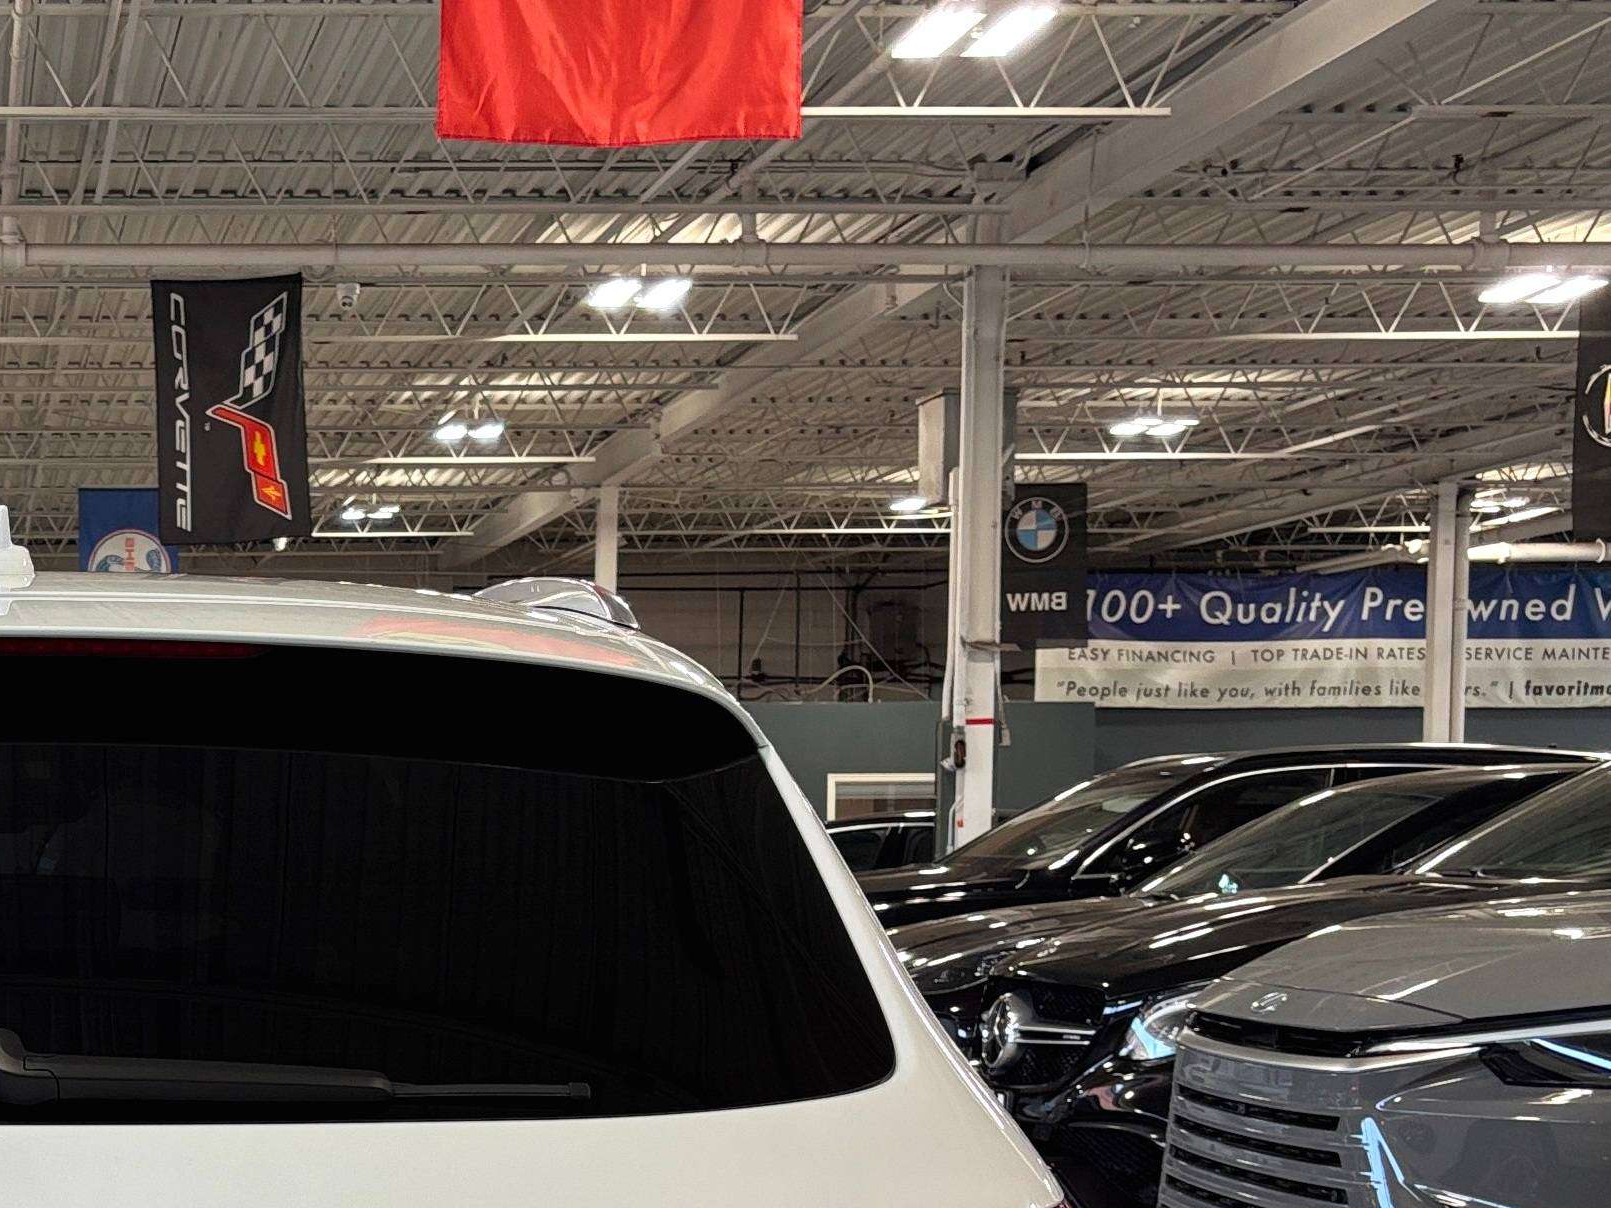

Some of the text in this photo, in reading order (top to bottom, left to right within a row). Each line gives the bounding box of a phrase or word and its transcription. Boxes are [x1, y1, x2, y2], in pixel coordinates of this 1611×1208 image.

[169, 292, 192, 532] CORVETTE
[1199, 587, 1345, 633] Quality
[1067, 648, 1110, 662] EASY
[1117, 649, 1216, 663] FINANCING
[1251, 648, 1285, 663] TOP
[1293, 646, 1368, 662] TRADE-IN
[1376, 646, 1426, 661] RATES
[1465, 646, 1533, 661] SERVICE
[1136, 681, 1169, 700] just
[1177, 680, 1210, 698] like
[1217, 687, 1256, 701] you,
[1264, 680, 1301, 697] with
[1309, 679, 1382, 697] families
[1389, 679, 1421, 697] like
